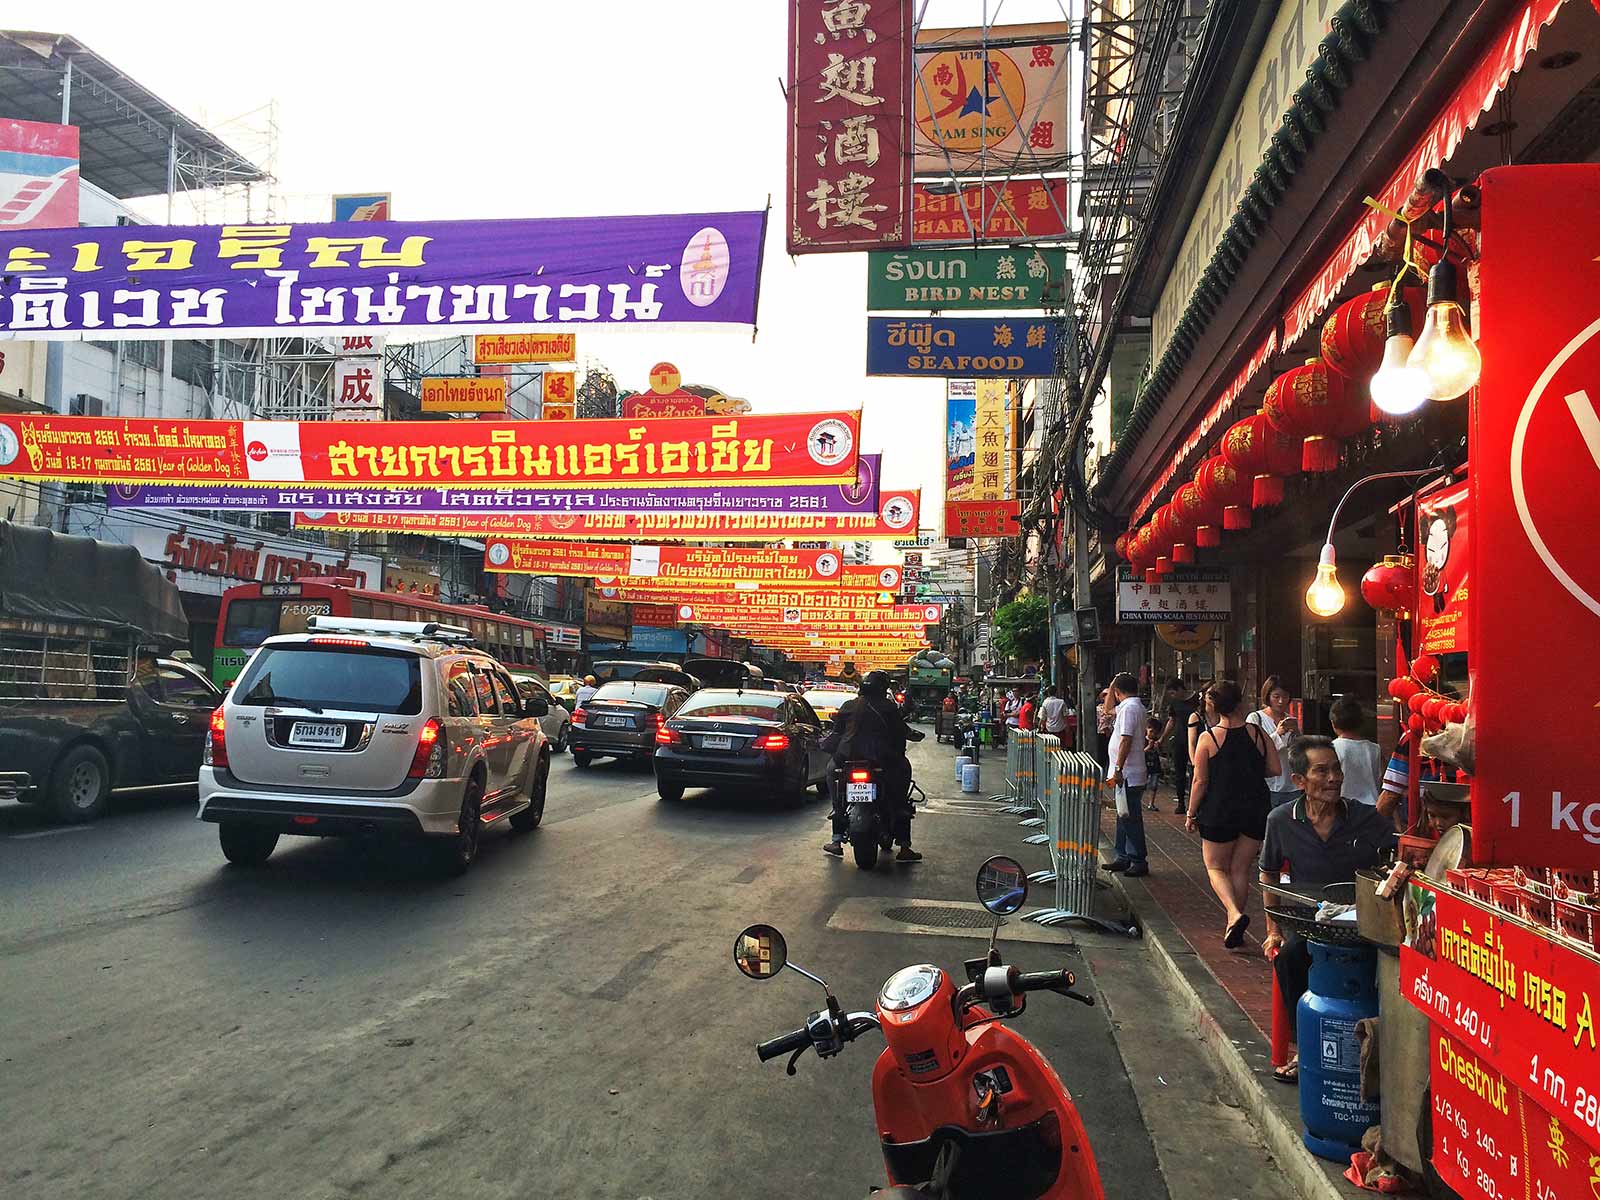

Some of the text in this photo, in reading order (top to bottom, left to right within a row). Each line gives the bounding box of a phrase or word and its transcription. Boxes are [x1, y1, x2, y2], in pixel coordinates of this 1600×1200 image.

[807, 0, 888, 230] 魚翅酒樓
[932, 126, 1006, 140] NAM SING
[989, 216, 1029, 232] FIN
[885, 254, 967, 281] รังนก
[0, 277, 228, 329] ติเวช
[905, 286, 1029, 302] BIRD NEST
[992, 324, 1047, 349] 海鮮
[907, 355, 1024, 370] SEAFOOD
[328, 421, 774, 477] สายการบินแอร์เอเชีย
[157, 456, 175, 475] Year
[177, 457, 186, 476] of
[186, 457, 212, 473] Golden
[214, 459, 231, 478] Dog
[517, 519, 532, 531] Dog
[281, 604, 331, 616] 7-50273
[318, 724, 343, 737] 9418
[1501, 791, 1600, 845] 1 kg
[1434, 990, 1451, 1019] กก.
[1455, 1001, 1478, 1036] 140
[1523, 970, 1567, 1030] เกรด
[1574, 991, 1596, 1048] A
[1439, 1036, 1509, 1116] Chestnut
[1528, 1053, 1539, 1084] 1
[1543, 1067, 1568, 1107] กก.
[1435, 1094, 1453, 1122] 1/2
[1455, 1109, 1470, 1139] Kg.
[1476, 1127, 1503, 1161] 140.-
[1442, 1136, 1449, 1155] 1
[1456, 1147, 1471, 1178] Kg.
